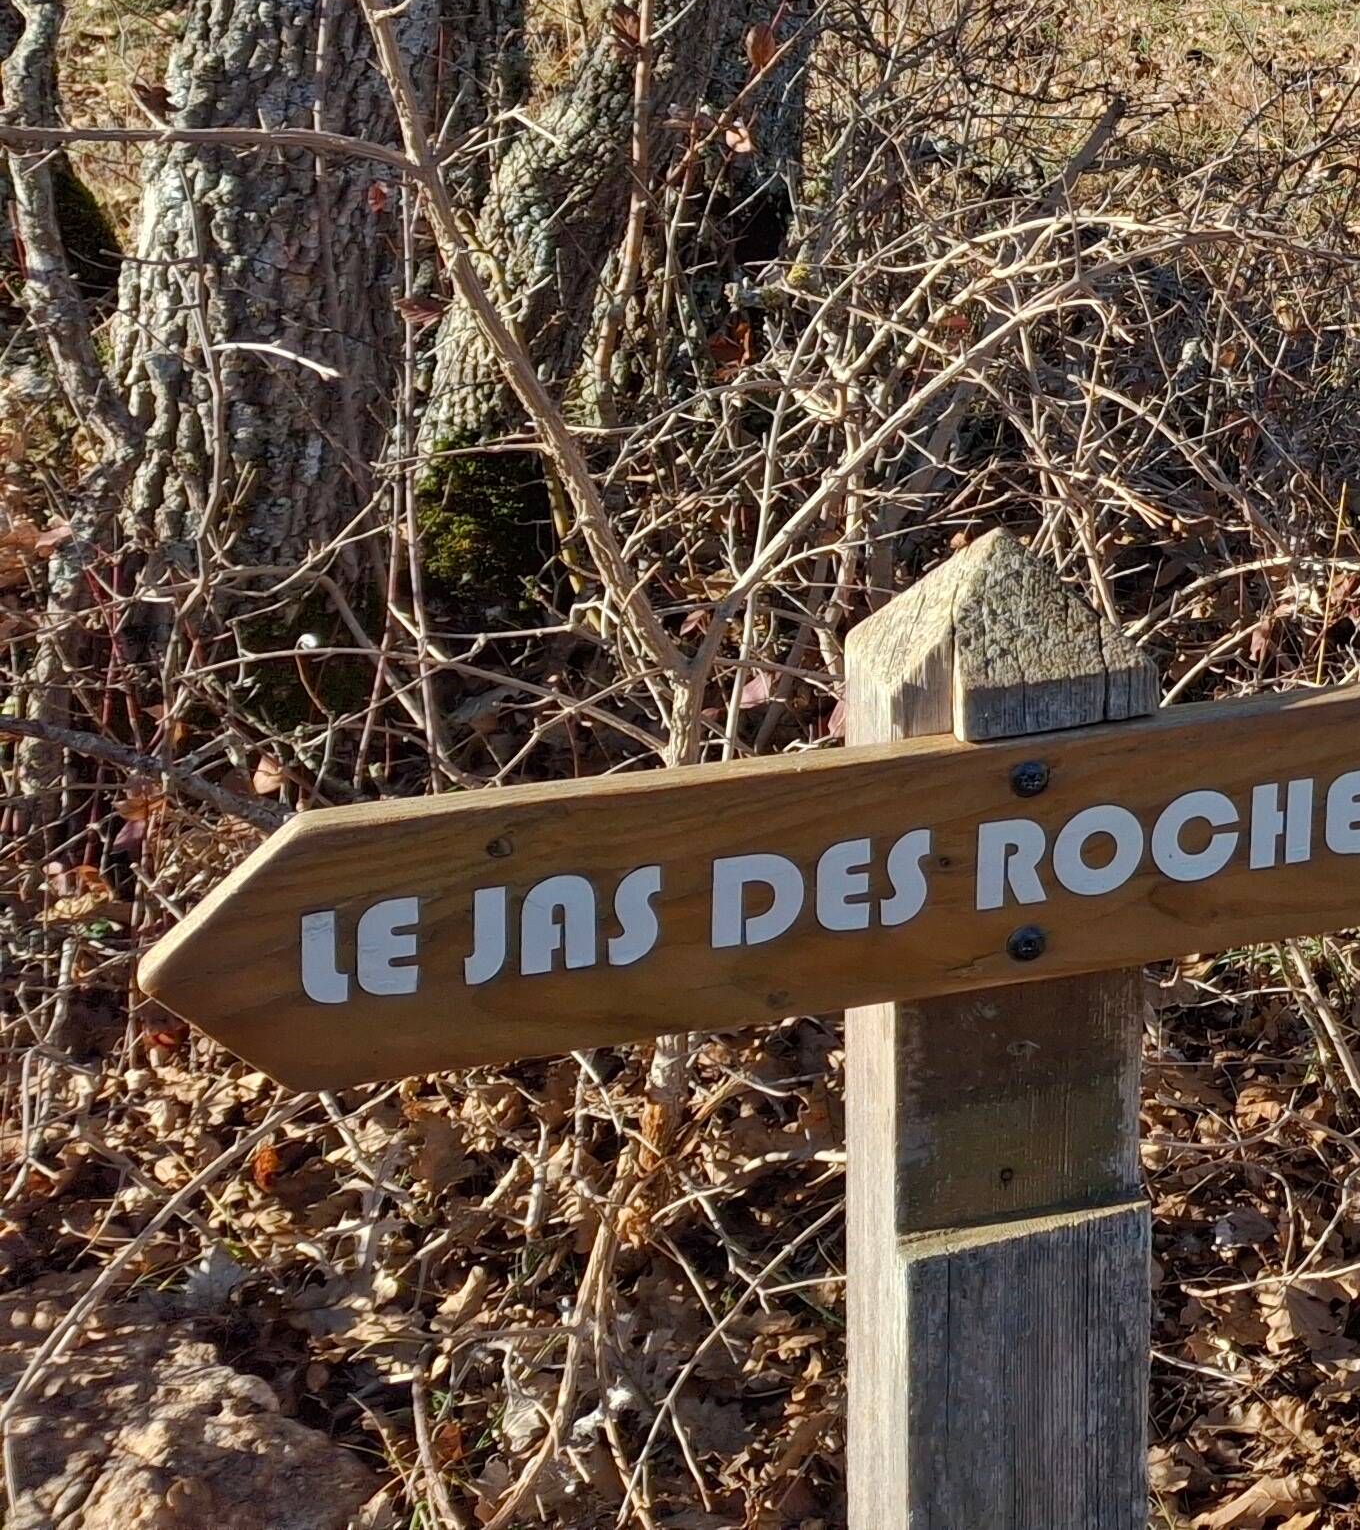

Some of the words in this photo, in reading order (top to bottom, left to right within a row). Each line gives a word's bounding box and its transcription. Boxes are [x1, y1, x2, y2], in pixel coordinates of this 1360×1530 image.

[302, 897, 418, 1003] LE
[465, 866, 660, 984] JAS
[712, 830, 930, 948] DES
